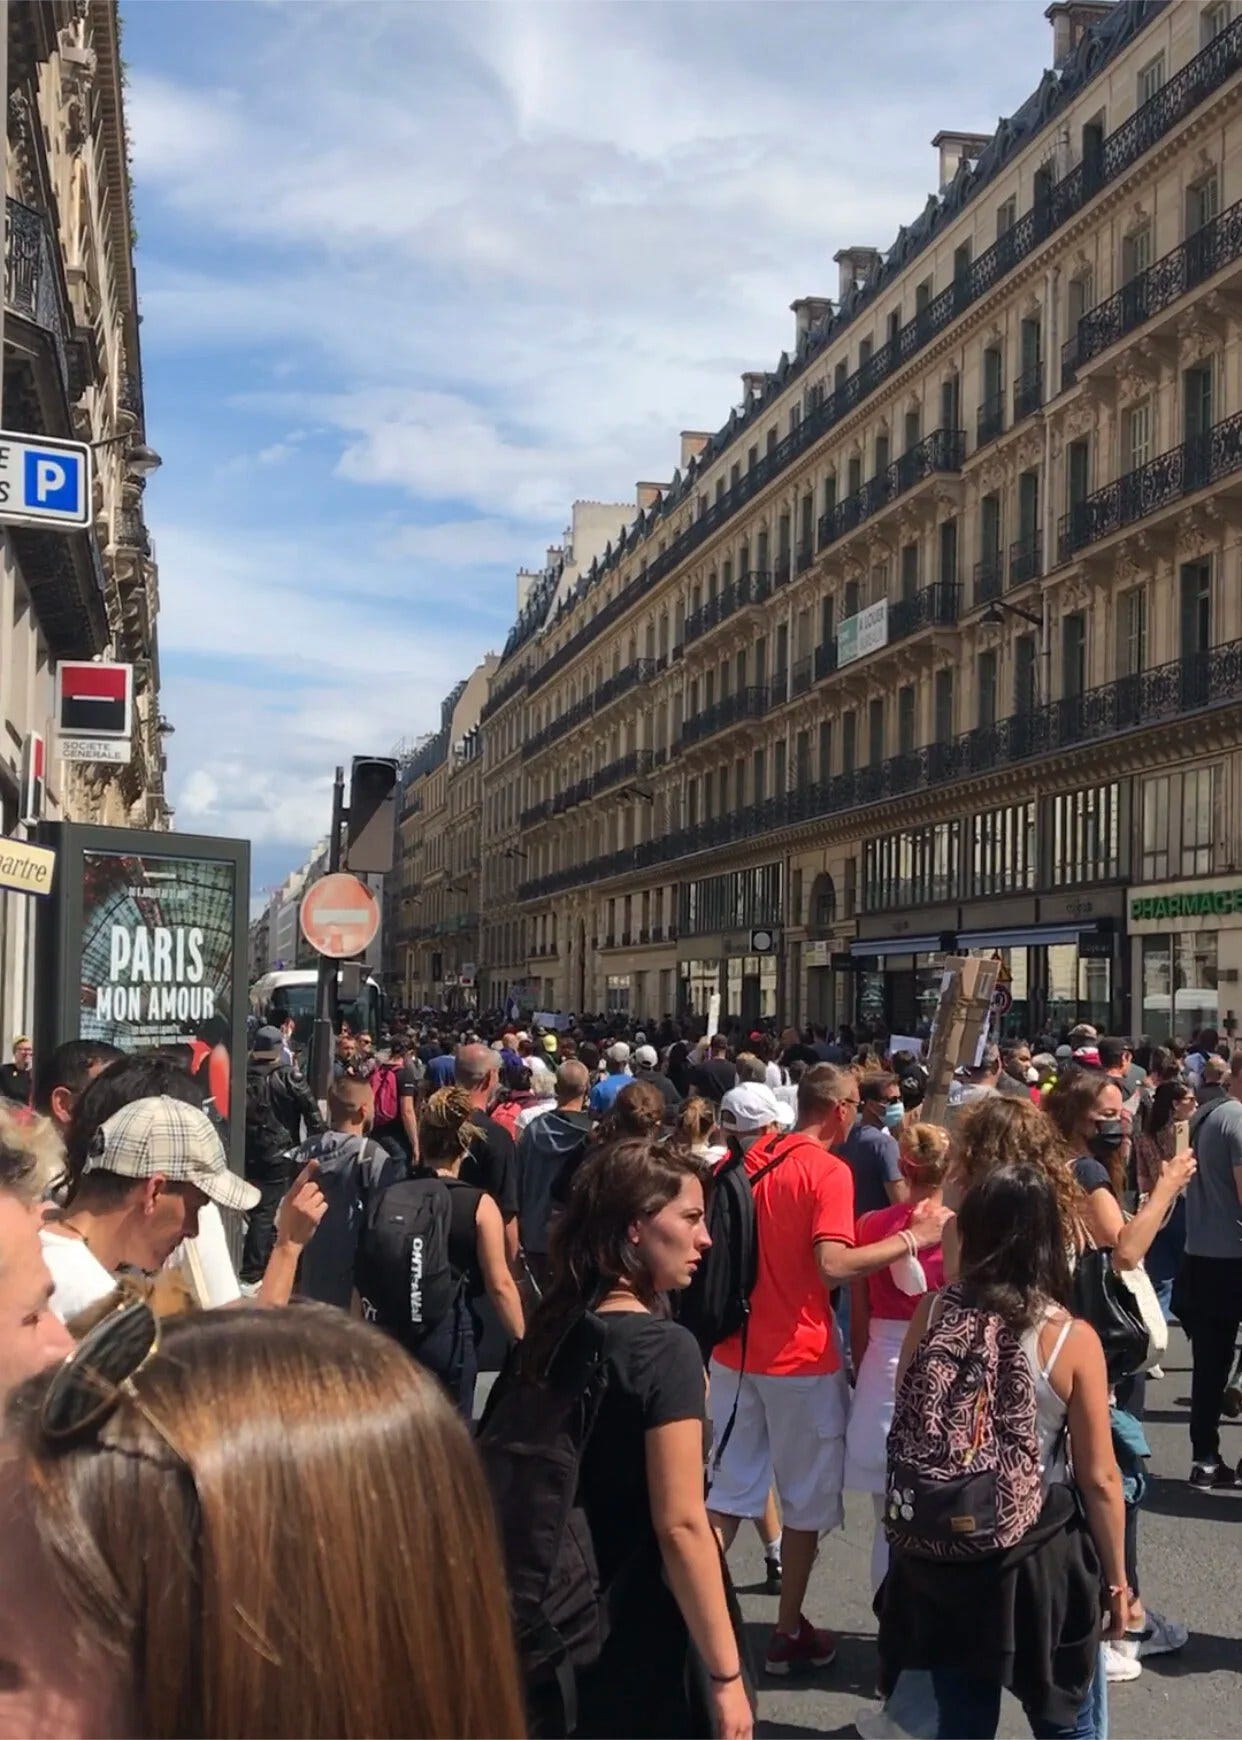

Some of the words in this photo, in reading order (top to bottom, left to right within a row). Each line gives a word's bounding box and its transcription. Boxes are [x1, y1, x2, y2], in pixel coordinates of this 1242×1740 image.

[37, 460, 66, 502] P
[0, 855, 47, 883] artre
[110, 924, 204, 983] PARIS
[97, 986, 141, 1021] MON
[148, 986, 215, 1021] AMOUR
